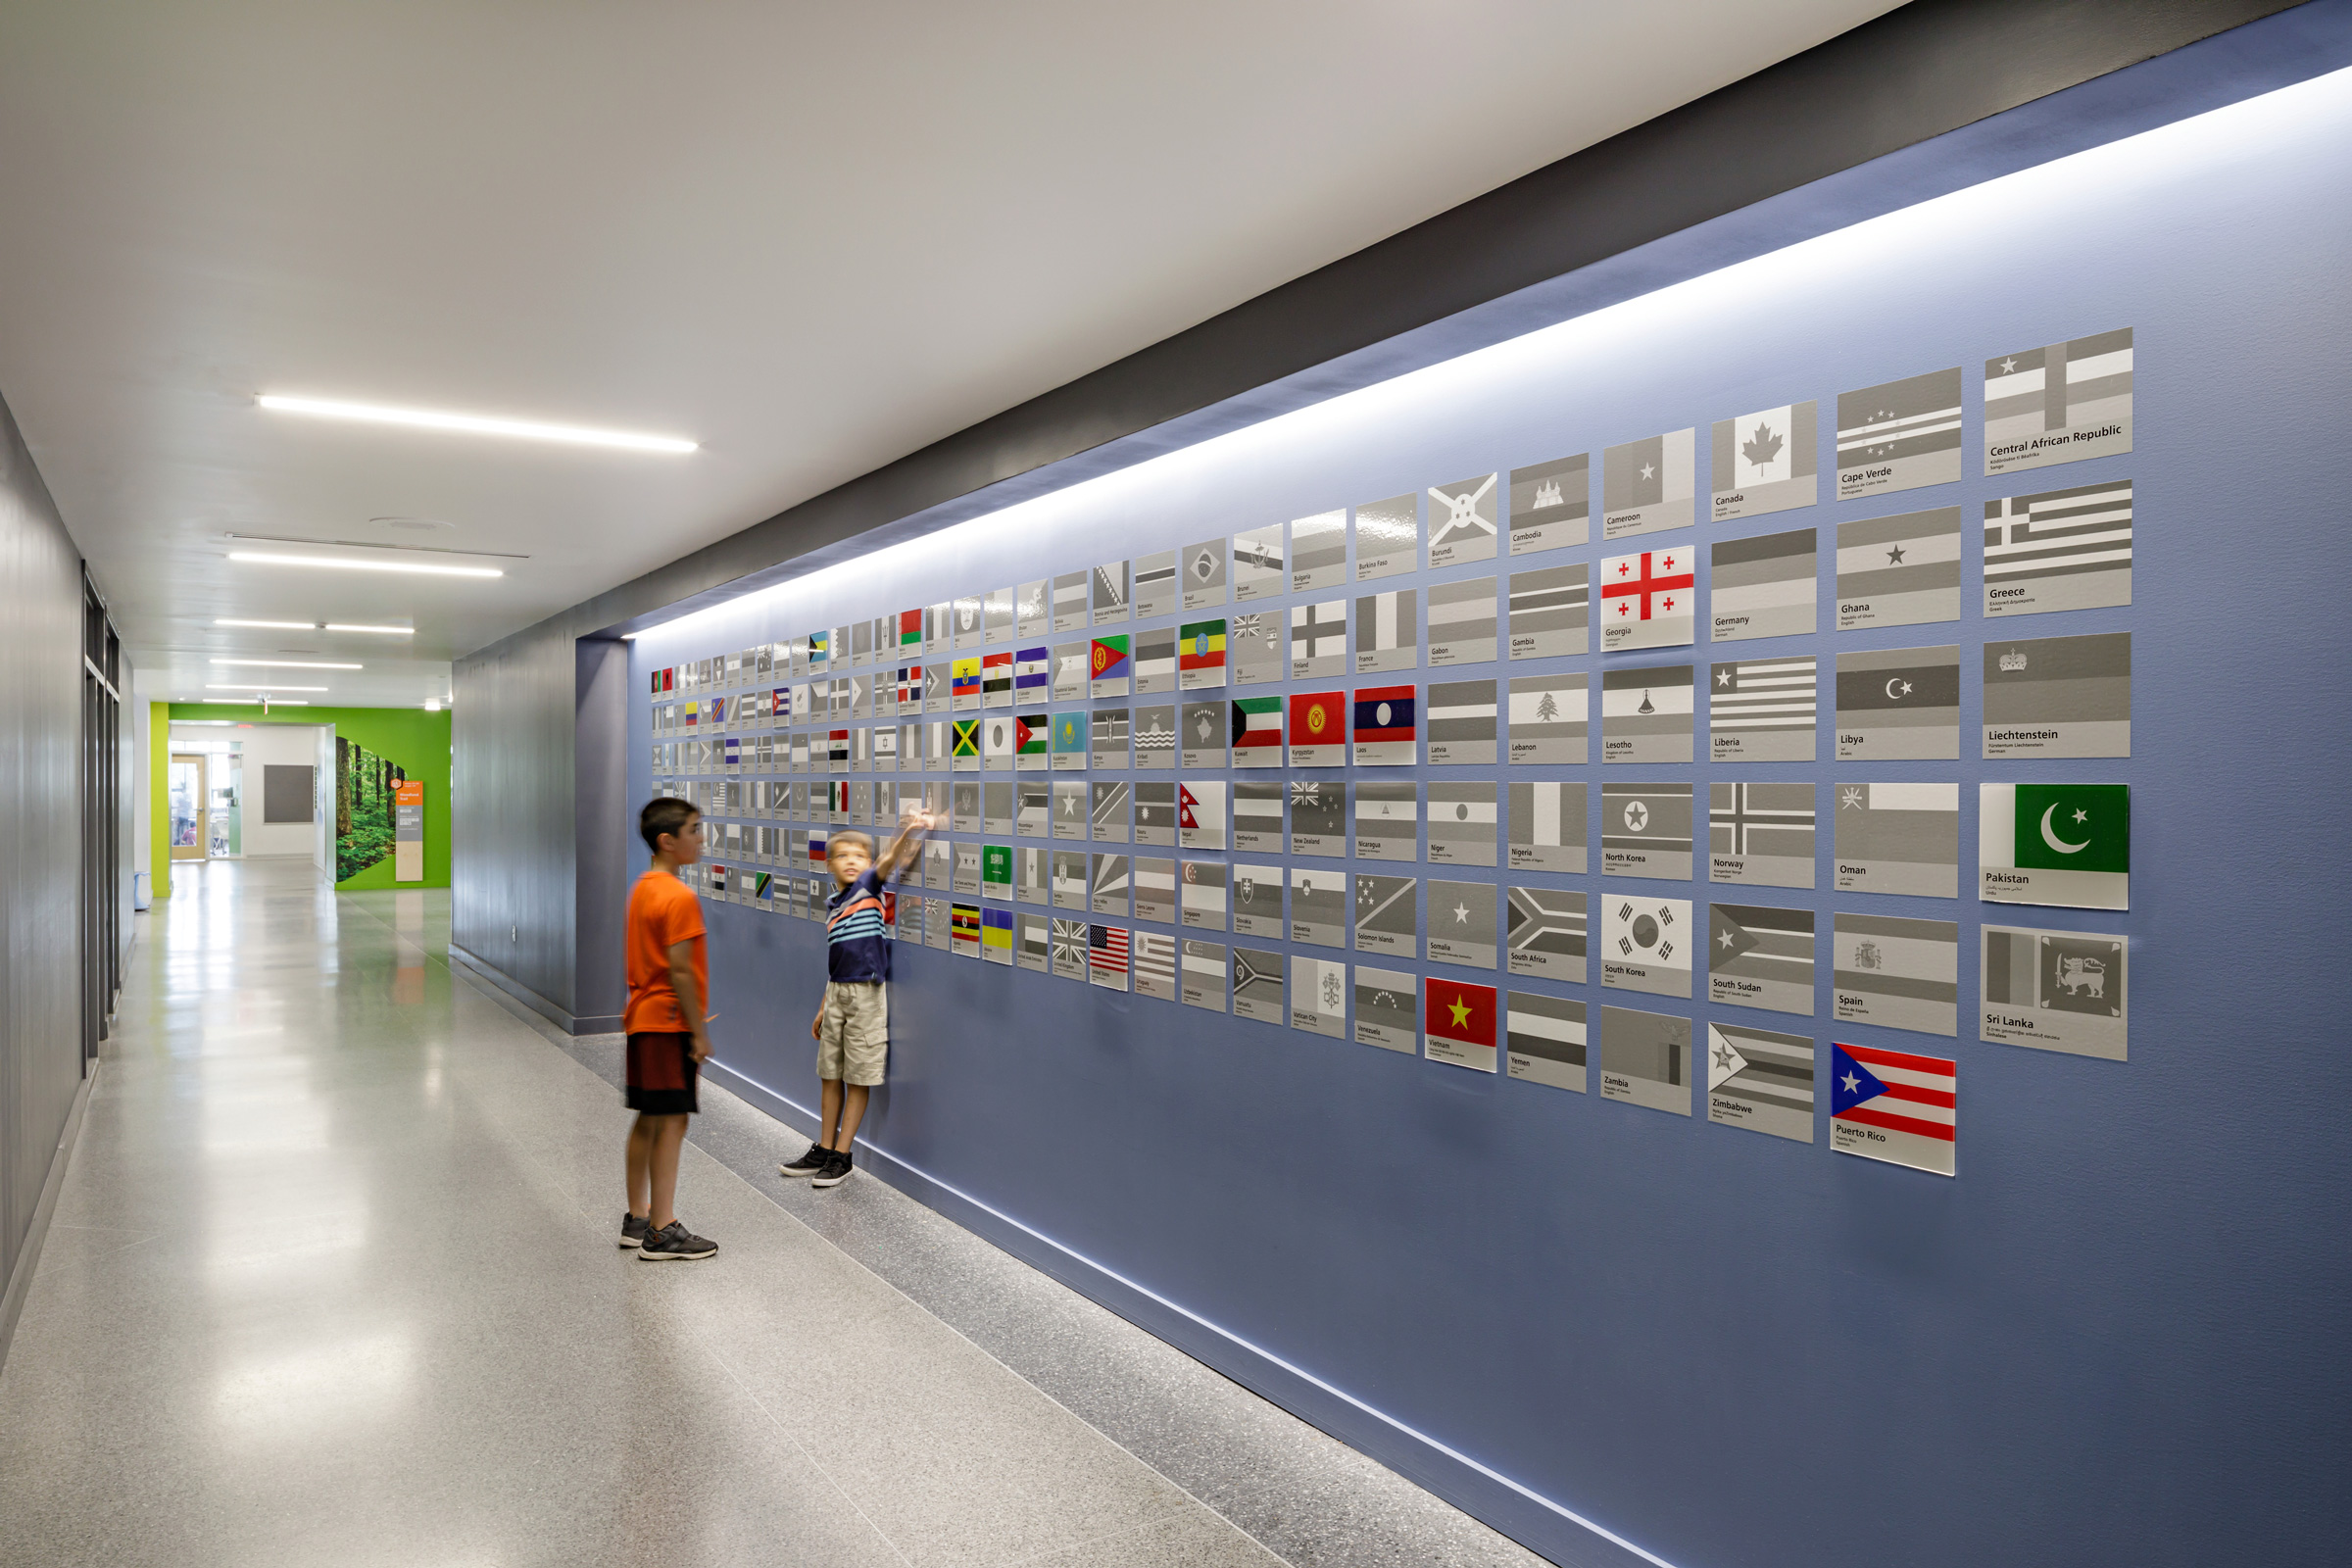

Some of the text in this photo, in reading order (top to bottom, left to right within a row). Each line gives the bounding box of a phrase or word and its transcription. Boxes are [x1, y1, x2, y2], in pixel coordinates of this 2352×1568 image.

[1991, 425, 2121, 456] Central African Republic
[1842, 467, 1892, 483] Cape Verde
[1716, 494, 1744, 505] Canada
[1607, 513, 1640, 525] Cameroon
[1513, 531, 1542, 541] Cambodia
[1432, 547, 1452, 557] Burundi
[1359, 562, 1376, 570] Burkina
[1294, 573, 1310, 581] Bulgaria
[1990, 588, 2025, 598] Greece
[1841, 604, 1869, 613] Ghana
[1715, 617, 1750, 626] Germany
[1606, 627, 1631, 636] Georgia
[1512, 638, 1534, 646] Gambia
[1841, 735, 1863, 745] Libya
[1989, 730, 2058, 740] Liechtenstein
[1715, 738, 1740, 746] Liberia
[1358, 841, 1381, 849] Nicaragua
[1431, 844, 1445, 853] Niger
[1511, 848, 1532, 857] Nigeria
[1606, 853, 1646, 862] North Korea
[1714, 858, 1744, 869] Norway
[1840, 865, 1866, 875] Oman
[1986, 873, 2029, 883] Pakistan
[1358, 932, 1394, 944] Solomon Islands
[1431, 942, 1451, 951] Somalia
[1511, 952, 1547, 964] South Africa
[1605, 965, 1645, 977] South Korea
[1137, 978, 1149, 987] Uruguay
[1713, 978, 1762, 992] South Sudan
[1184, 989, 1202, 997] Uzbekistan
[1839, 995, 1862, 1006] Spain
[1293, 1011, 1308, 1019] Vatican
[1987, 1014, 2034, 1029] Sri Lanka
[1357, 1025, 1381, 1035] Venezuela
[1429, 1039, 1450, 1049] Vietnam
[1511, 1057, 1530, 1067] Yemen
[1604, 1075, 1628, 1088] Zambia
[1712, 1098, 1752, 1114] Zimbabwe
[1836, 1124, 1886, 1142] Puerto Rico
